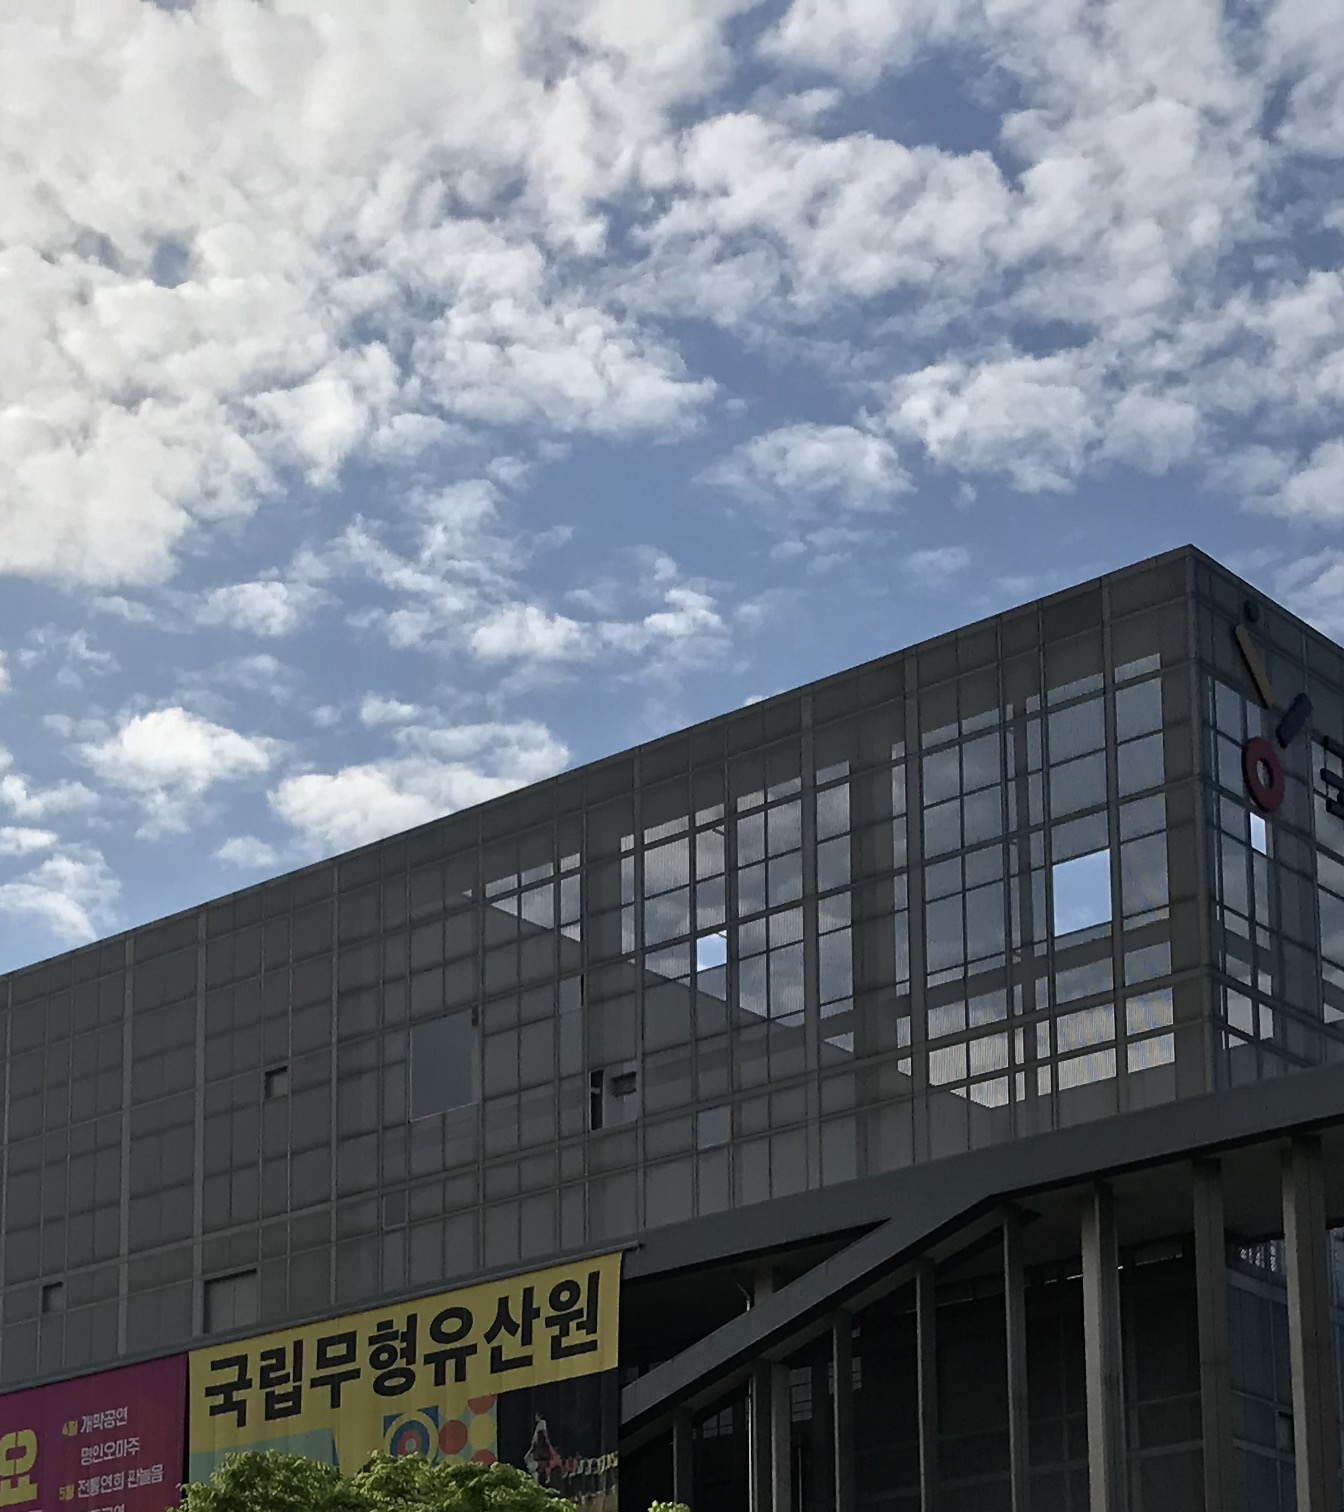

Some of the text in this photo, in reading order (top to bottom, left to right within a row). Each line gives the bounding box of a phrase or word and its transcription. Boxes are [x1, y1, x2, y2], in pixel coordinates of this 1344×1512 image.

[204, 1271, 601, 1427] 국립무형유산원
[80, 1406, 128, 1433] 개막공연
[81, 1437, 140, 1466] 명인오마주
[77, 1471, 125, 1498] 전통연희
